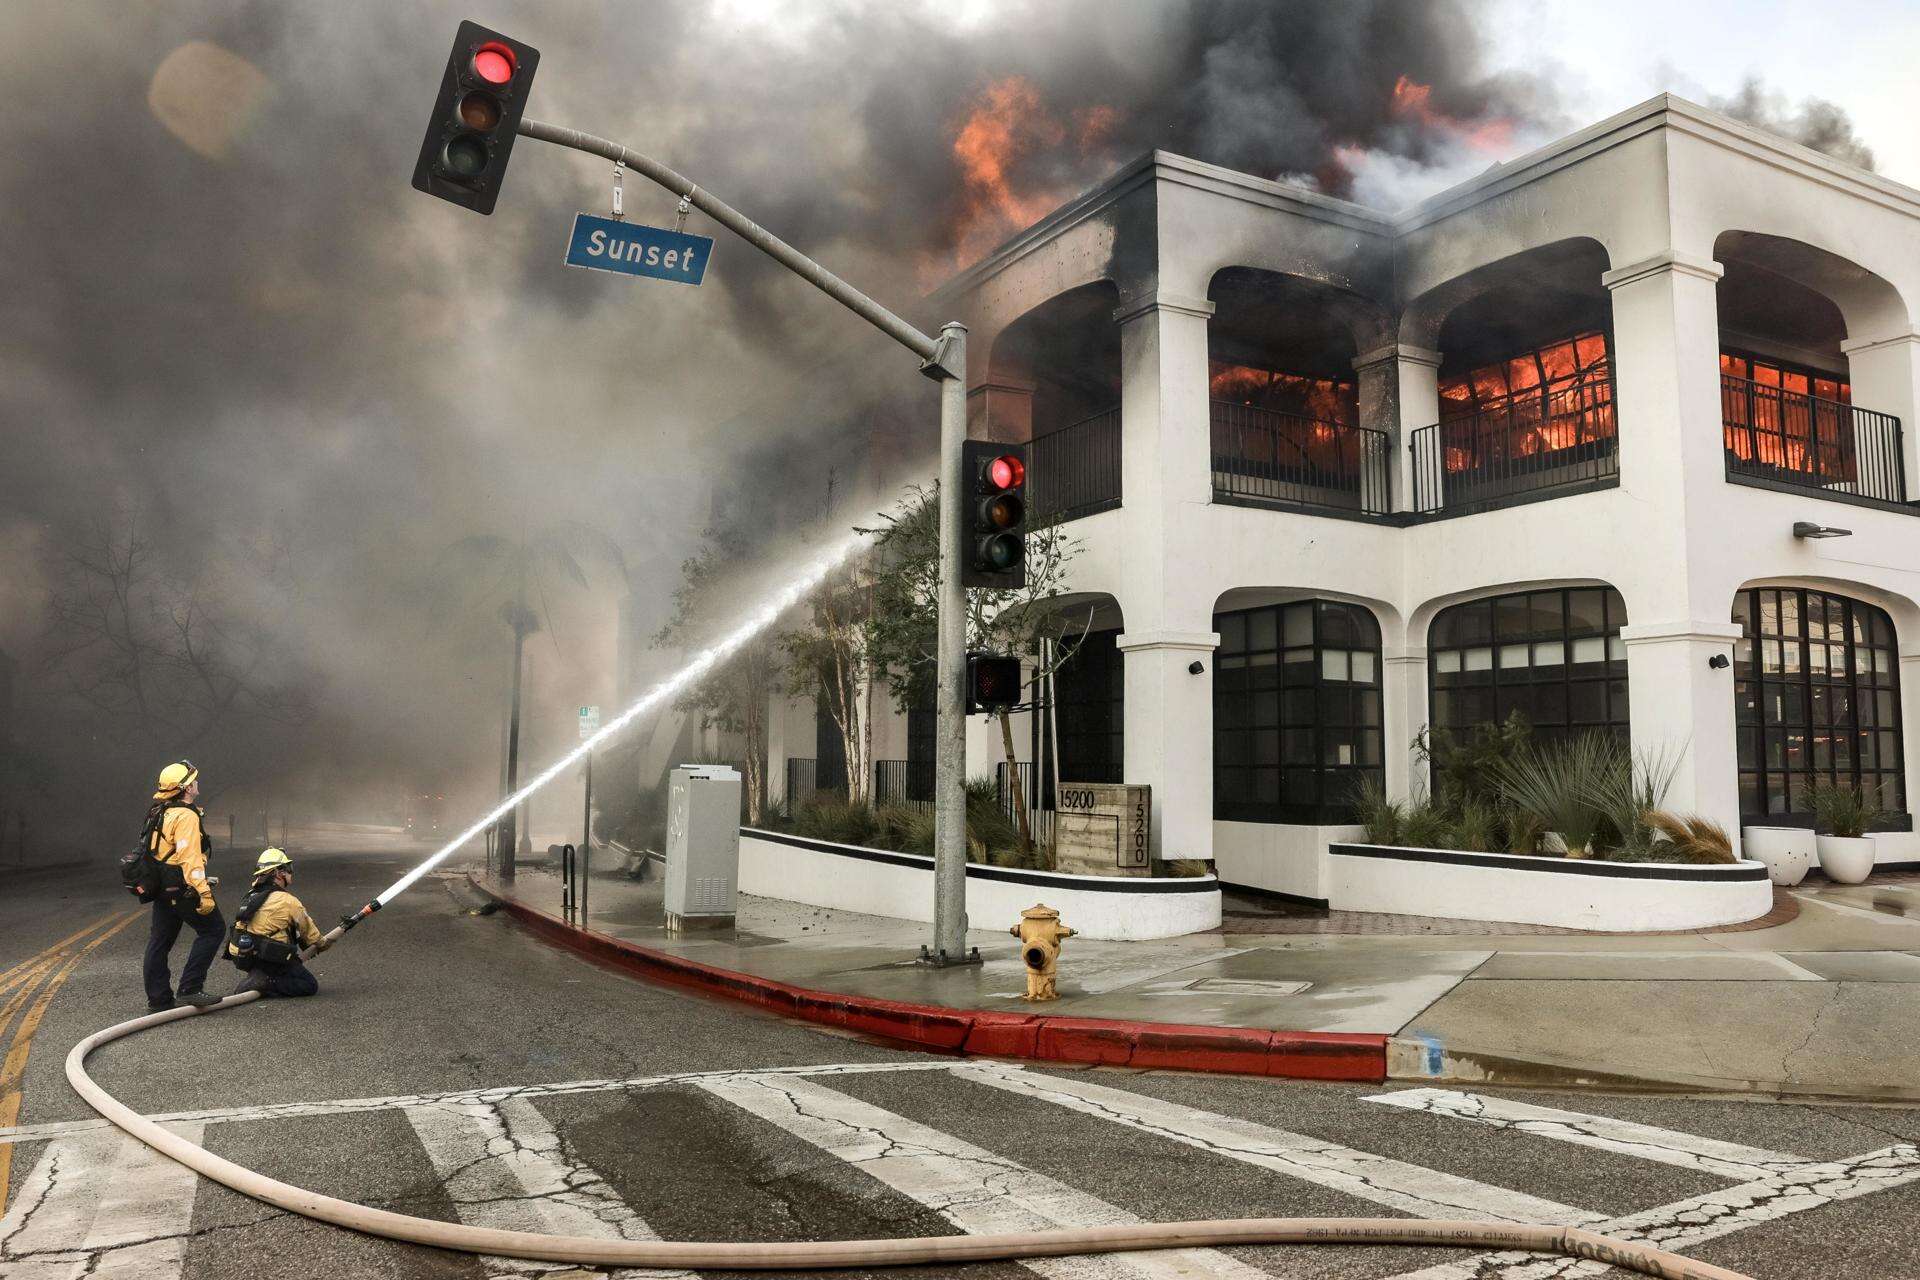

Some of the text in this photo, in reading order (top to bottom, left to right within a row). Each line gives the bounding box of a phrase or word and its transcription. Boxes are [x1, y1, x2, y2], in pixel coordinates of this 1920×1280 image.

[586, 230, 695, 272] Sunset
[1060, 790, 1095, 809] 15200
[1135, 788, 1144, 863] 15200
